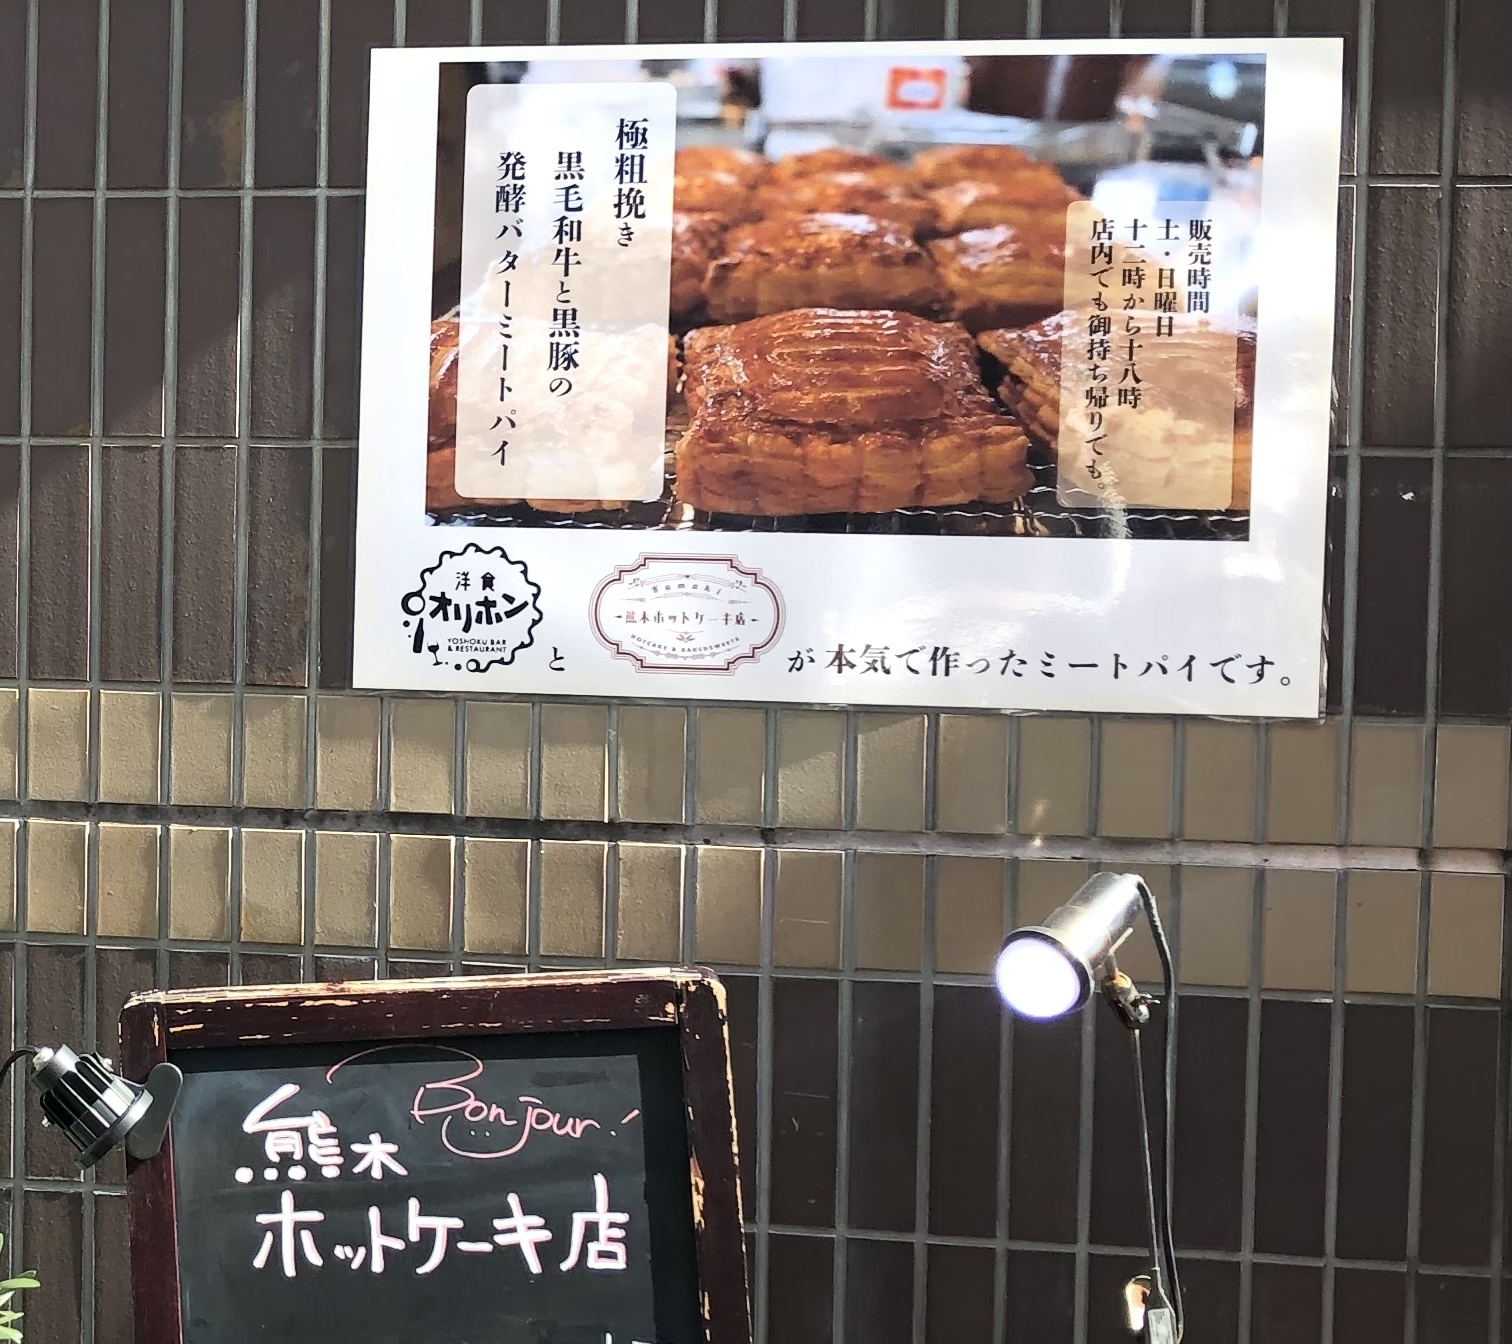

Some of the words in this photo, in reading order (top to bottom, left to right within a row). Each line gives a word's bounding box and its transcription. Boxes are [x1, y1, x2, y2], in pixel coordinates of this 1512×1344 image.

[613, 118, 649, 247] 極粗挽き
[489, 151, 527, 466] 発酵バターミートパイ
[547, 151, 585, 397] 黒毛和牛と黒豚の
[1118, 218, 1148, 409] 十二時から十八時
[1154, 218, 1180, 337] 土・日曜日
[1187, 218, 1213, 314] 販売時間
[1085, 218, 1115, 490] 店内でも御持ち帰りでも。
[429, 591, 529, 633] オリホン
[455, 571, 496, 592] 洋食
[447, 637, 487, 646] YOSHOKU
[456, 645, 507, 653] RESTAURANT
[549, 646, 566, 672] と
[234, 1083, 408, 1183] 熊木
[252, 1172, 630, 1277] ホットケーキ店
